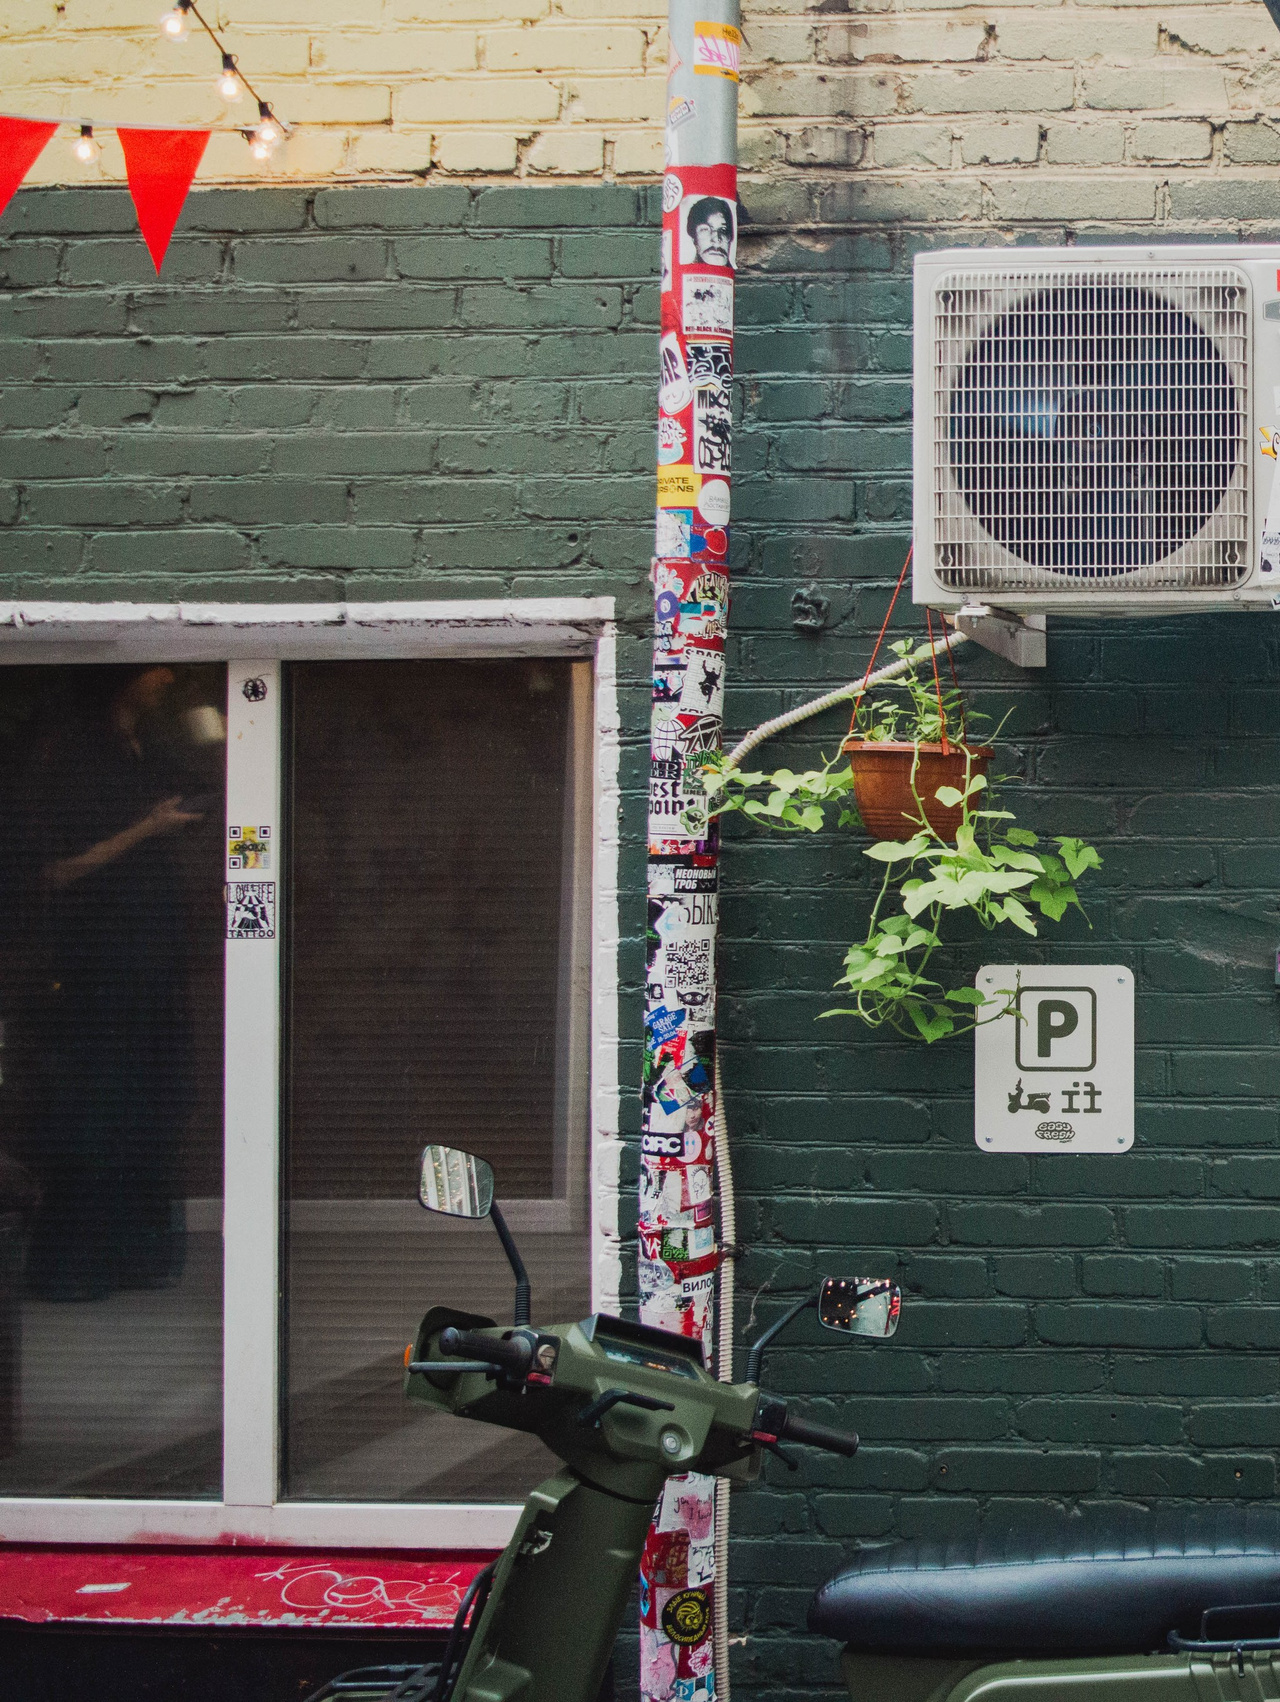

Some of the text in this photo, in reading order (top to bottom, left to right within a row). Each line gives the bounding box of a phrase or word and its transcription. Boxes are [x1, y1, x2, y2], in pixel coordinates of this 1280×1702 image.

[674, 879, 698, 890] ГРОБ
[228, 929, 275, 938] TATTOO
[652, 1012, 677, 1030] GARAGE
[1037, 999, 1079, 1058] P
[1037, 1121, 1073, 1131] easy
